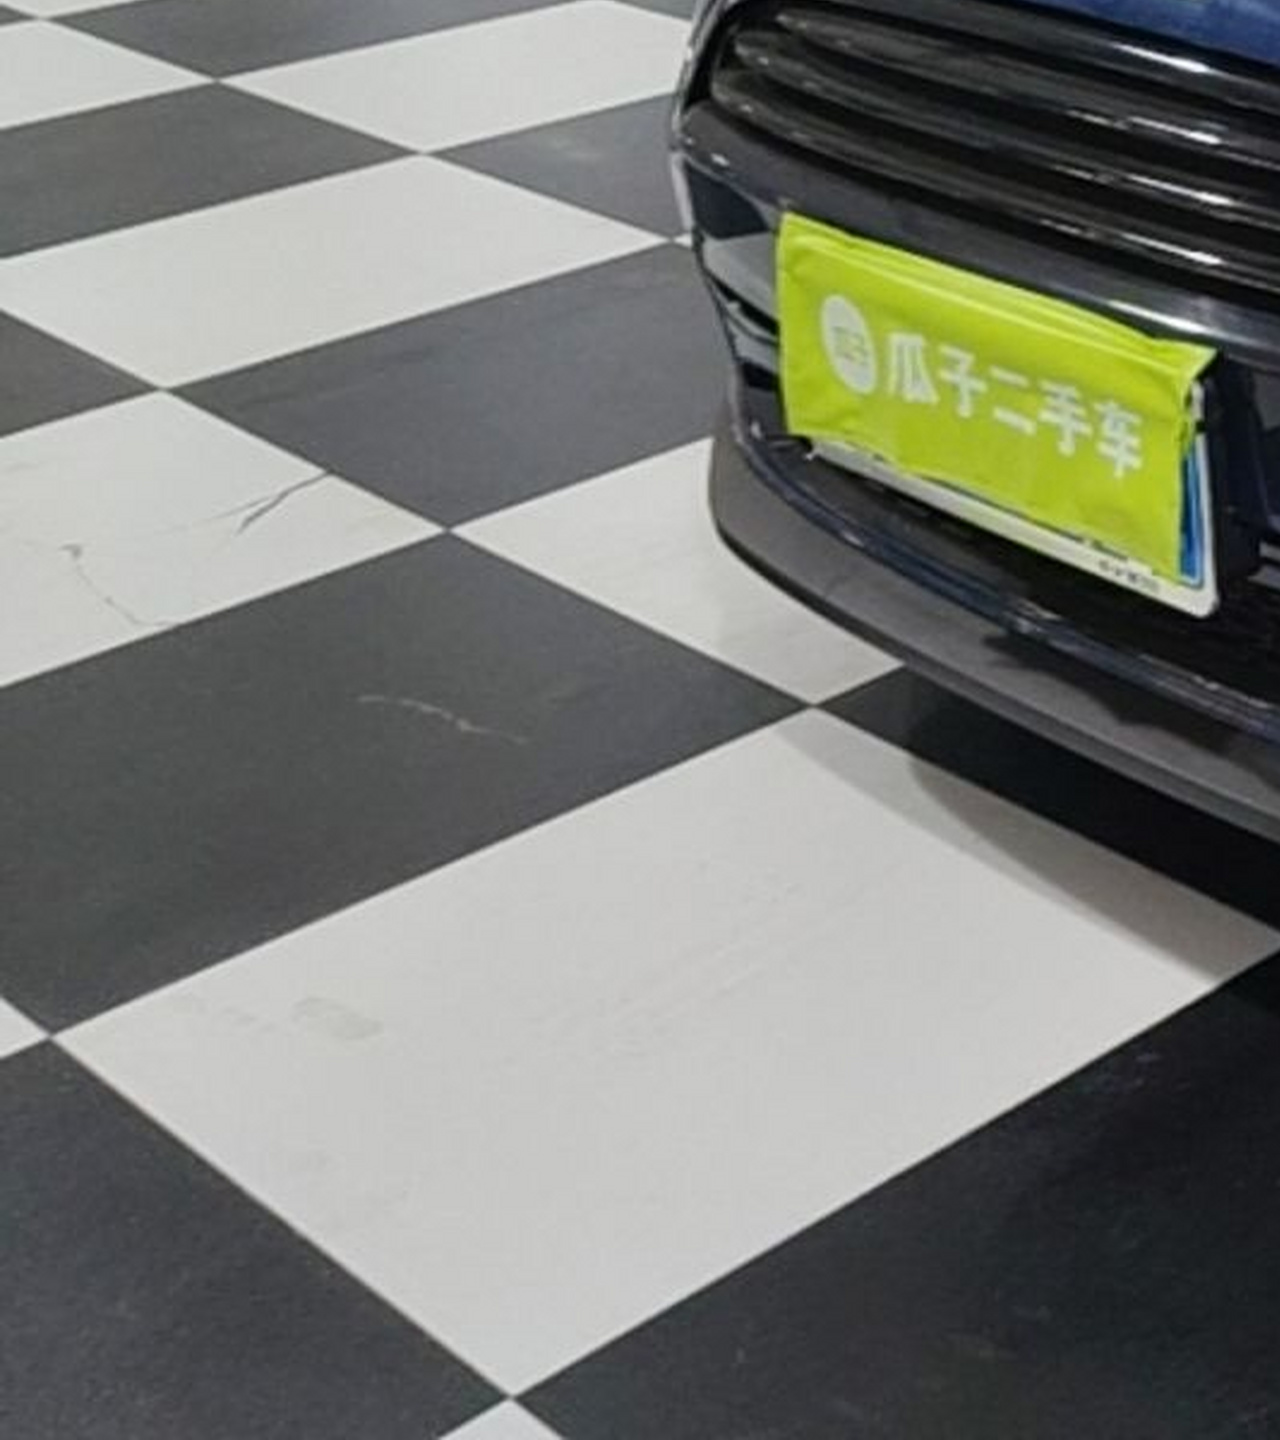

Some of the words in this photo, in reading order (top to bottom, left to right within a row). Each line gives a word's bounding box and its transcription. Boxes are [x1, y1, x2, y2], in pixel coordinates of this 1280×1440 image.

[886, 332, 1143, 478] 瓜子二手车
